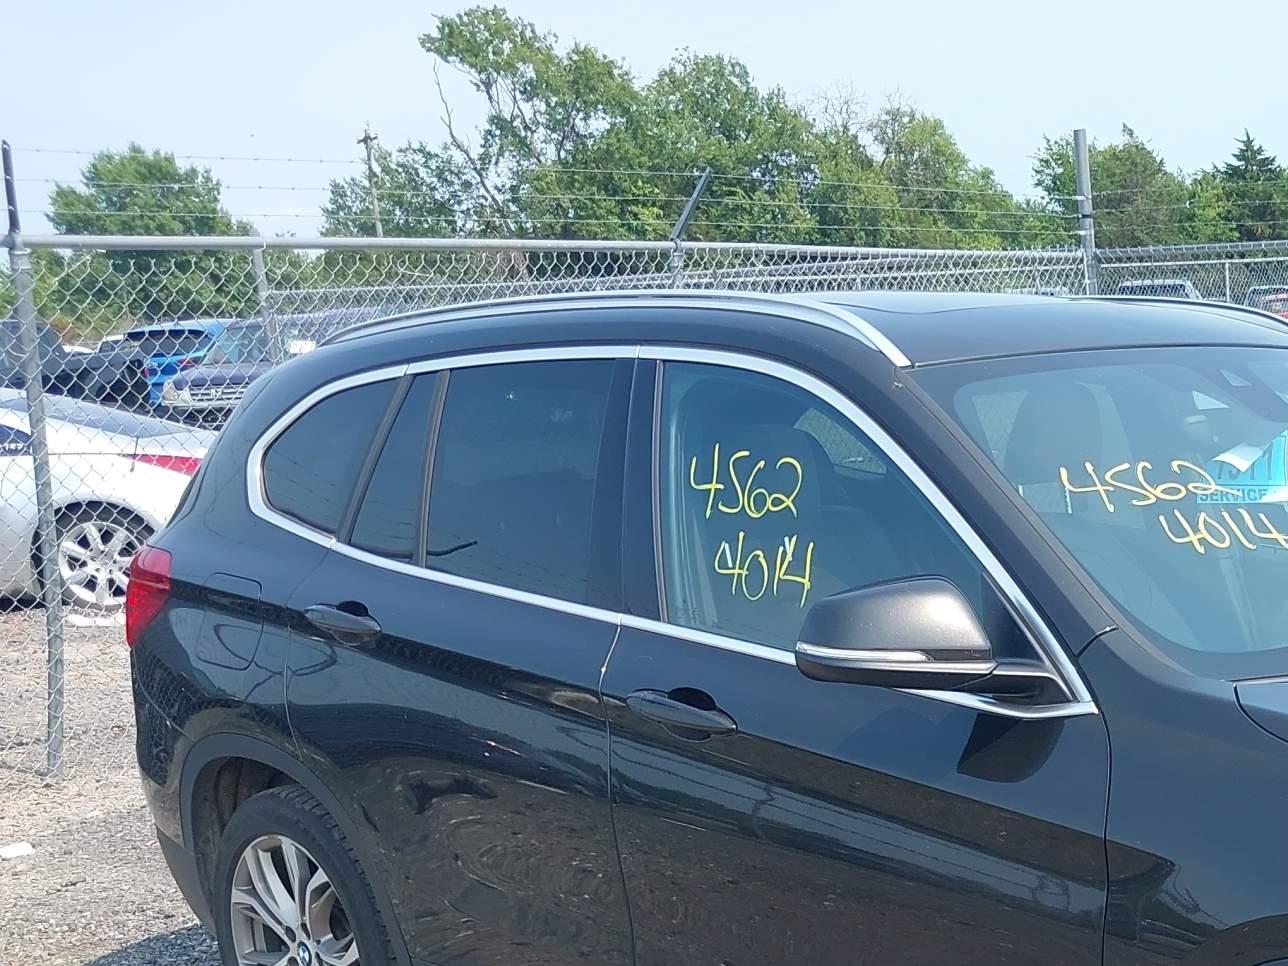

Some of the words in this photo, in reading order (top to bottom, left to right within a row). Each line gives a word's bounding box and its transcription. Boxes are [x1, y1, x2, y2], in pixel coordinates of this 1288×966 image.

[689, 442, 803, 520] 4562
[1059, 460, 1242, 514] 4562
[714, 530, 815, 609] 4014
